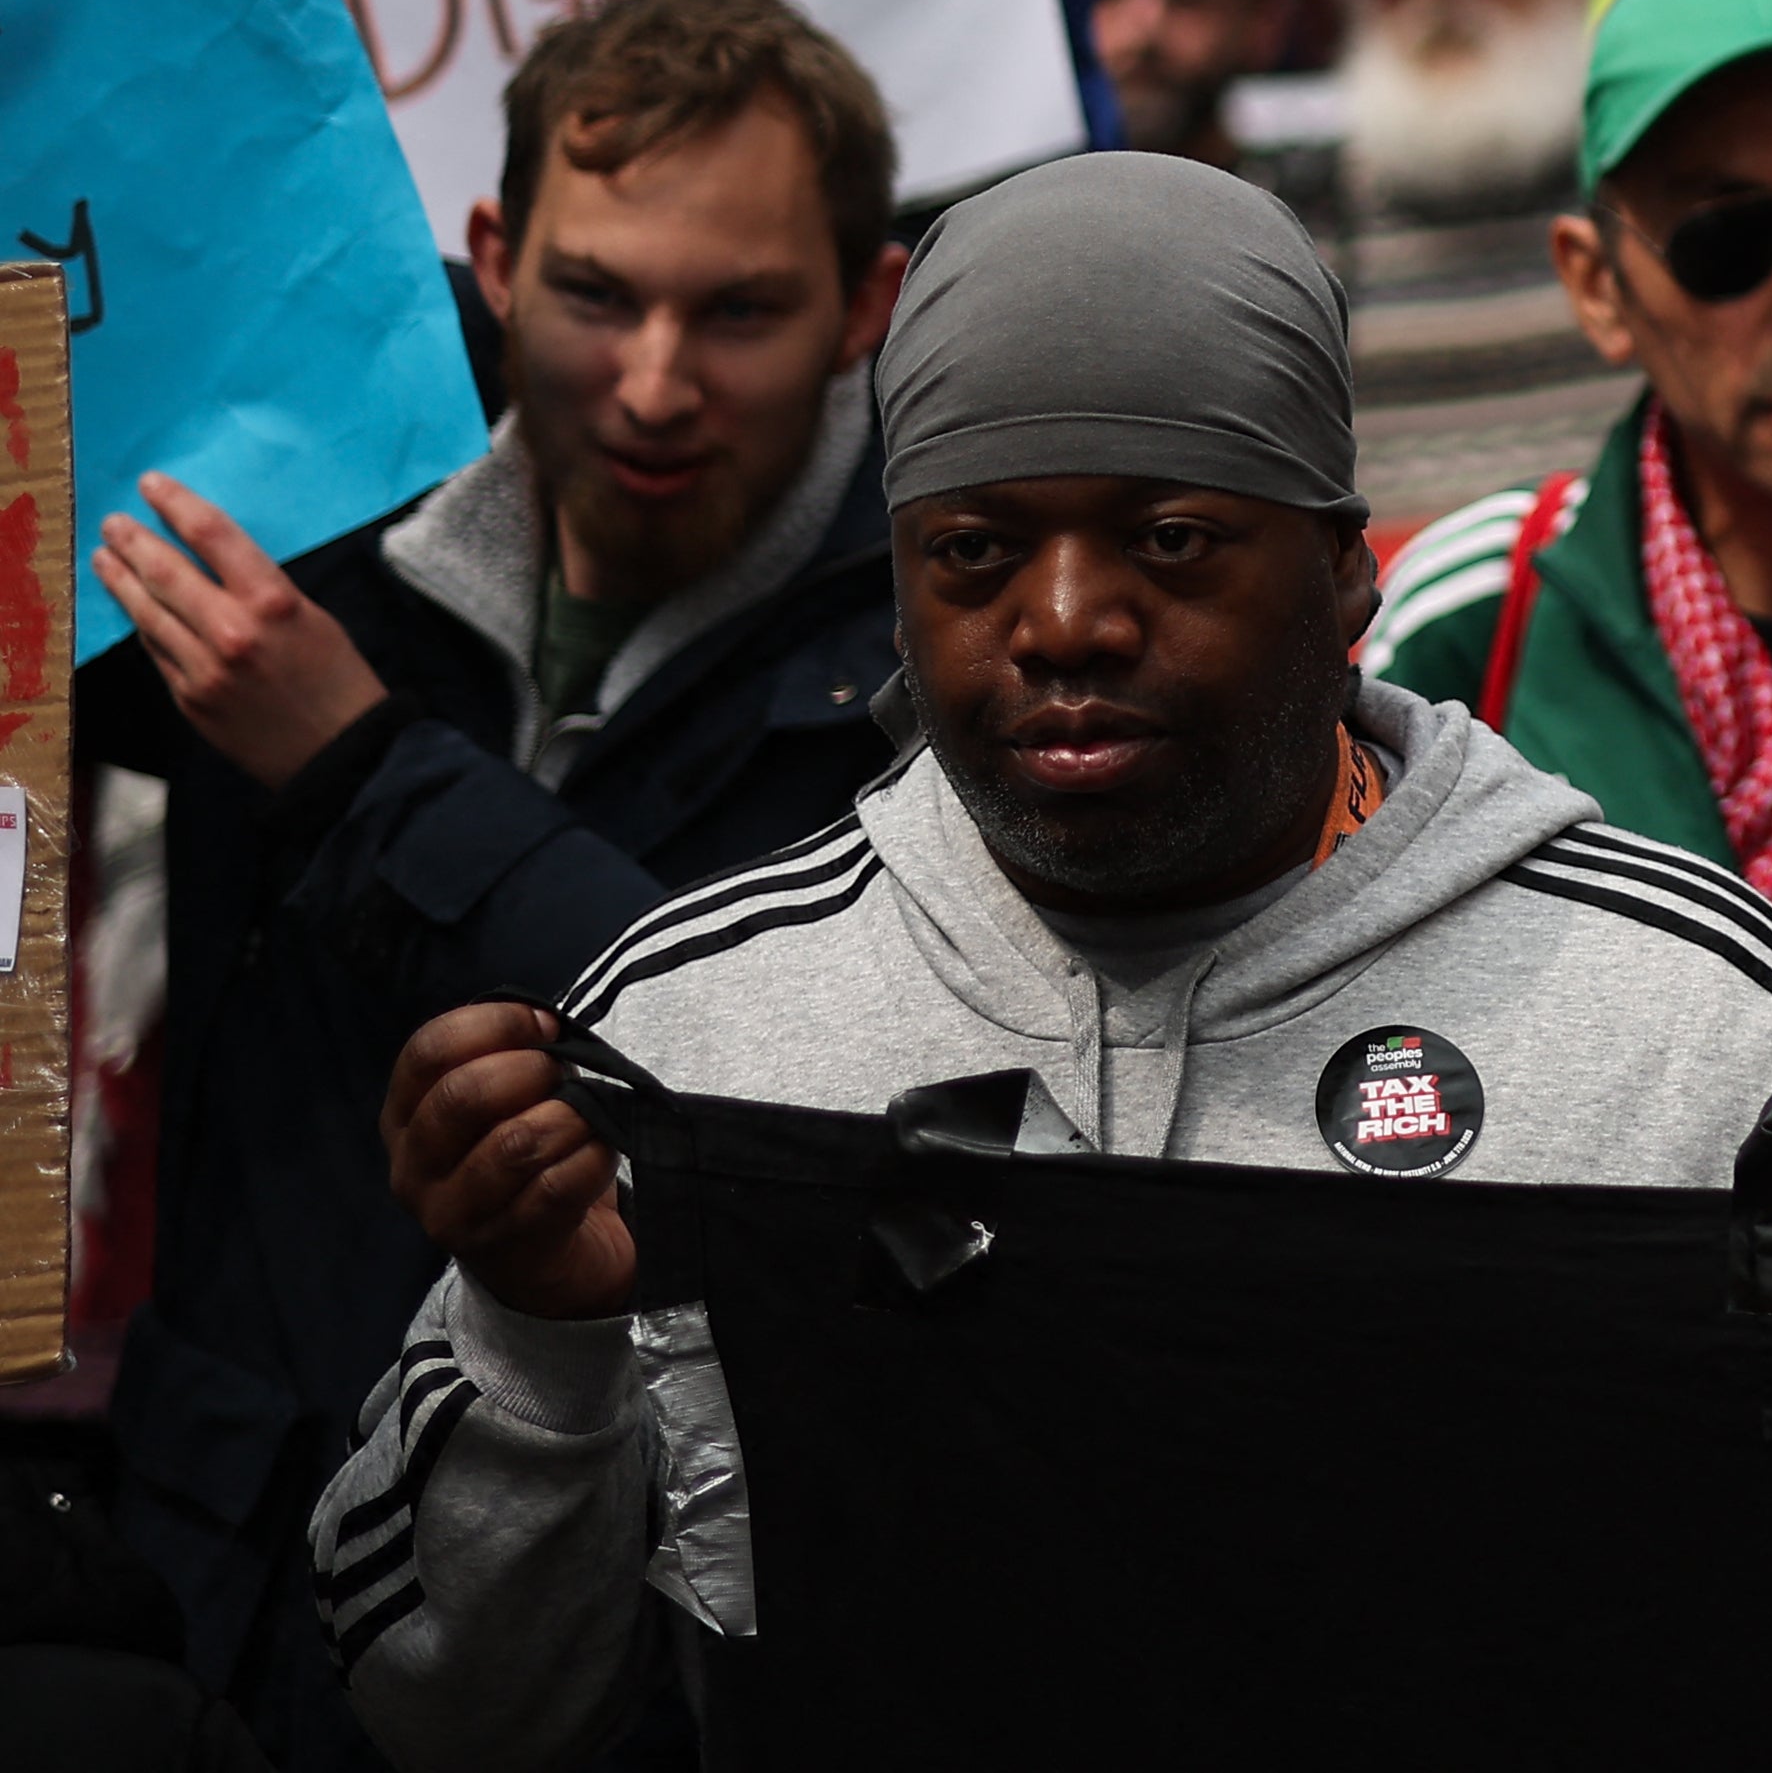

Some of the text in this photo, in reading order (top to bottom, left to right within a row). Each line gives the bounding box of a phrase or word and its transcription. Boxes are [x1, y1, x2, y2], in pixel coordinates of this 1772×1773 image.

[1366, 1048, 1423, 1066] peoples
[1368, 1044, 1386, 1053] the
[1370, 1060, 1421, 1072] assembly
[1359, 1075, 1437, 1099] TAX
[1362, 1094, 1437, 1118] THE
[1357, 1112, 1446, 1140] RICH
